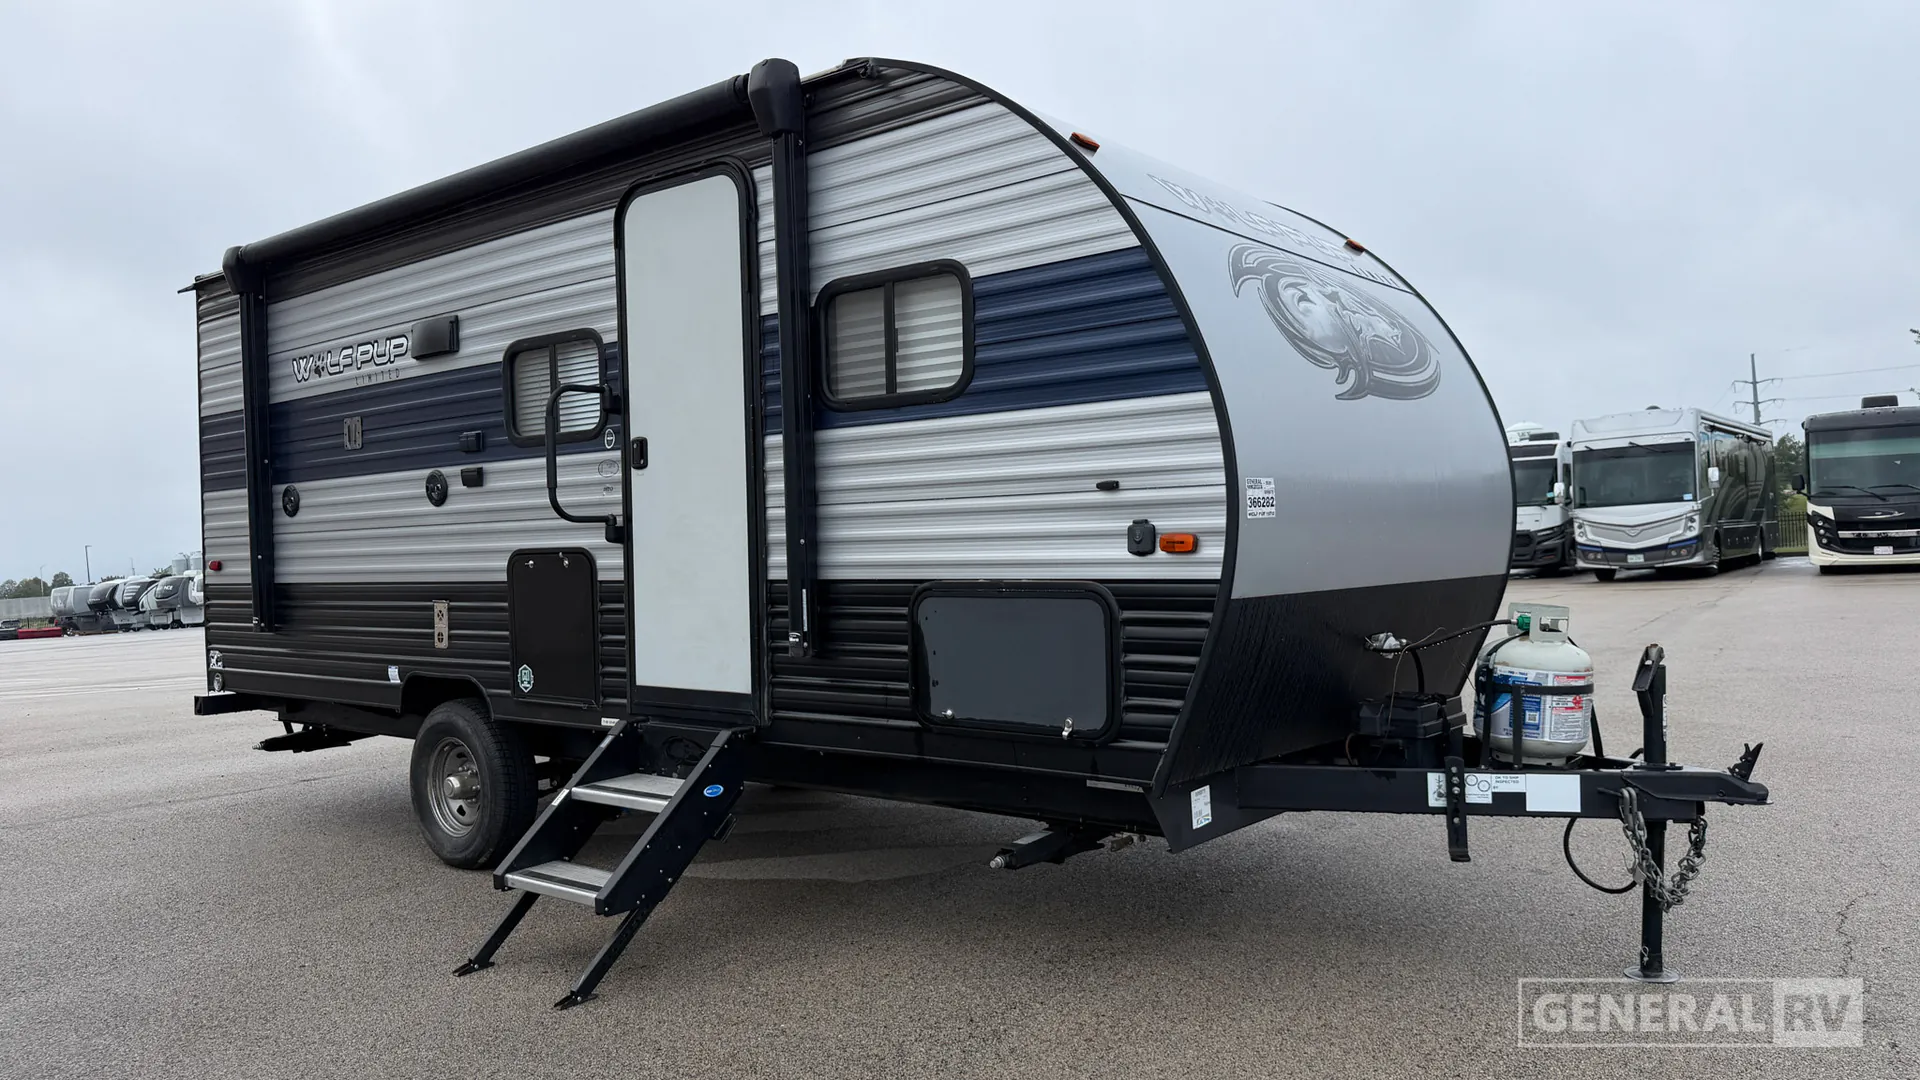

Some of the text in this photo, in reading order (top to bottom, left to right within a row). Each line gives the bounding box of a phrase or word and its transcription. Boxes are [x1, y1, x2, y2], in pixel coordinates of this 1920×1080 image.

[356, 334, 409, 370] PUP
[354, 367, 400, 386] LIMITED
[1248, 496, 1275, 508] 366282
